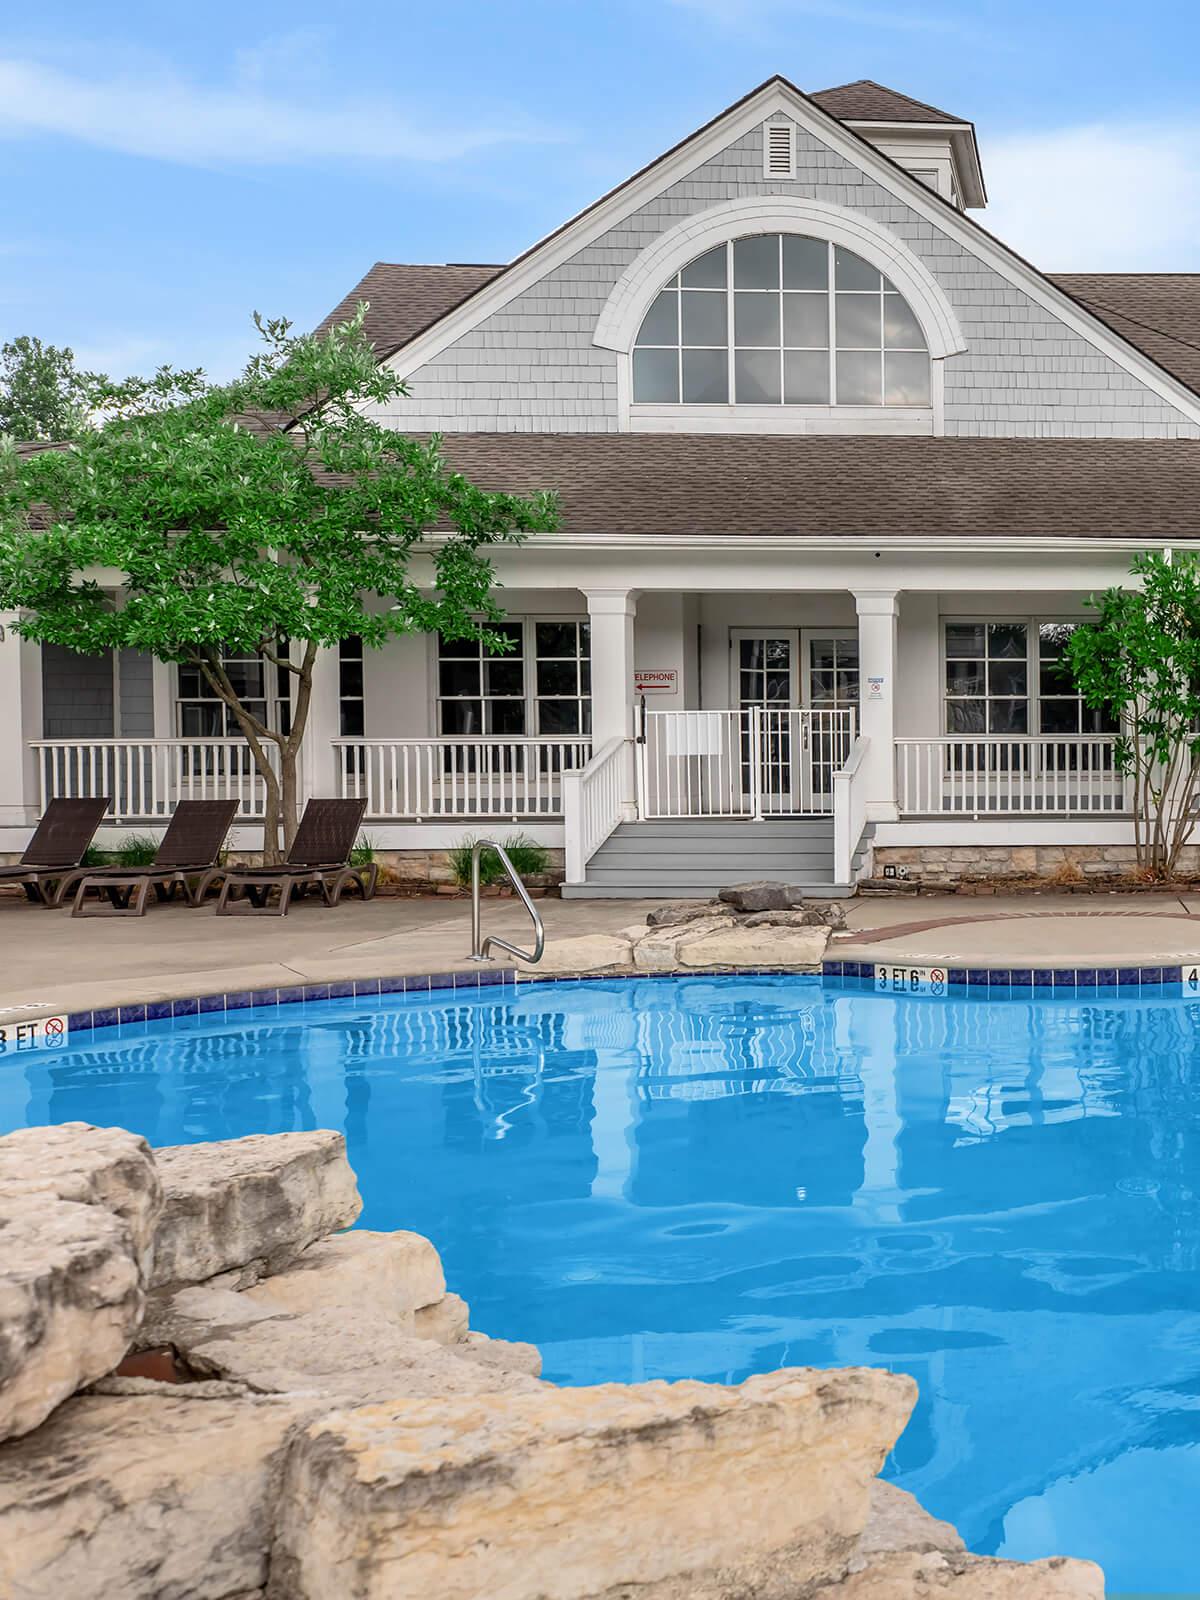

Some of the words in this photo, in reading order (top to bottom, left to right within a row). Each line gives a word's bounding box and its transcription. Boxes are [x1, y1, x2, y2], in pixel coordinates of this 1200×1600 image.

[635, 673, 675, 681] ELEPHONE
[879, 967, 887, 982] 3
[911, 970, 919, 984] 6
[1188, 968, 1199, 983] 4
